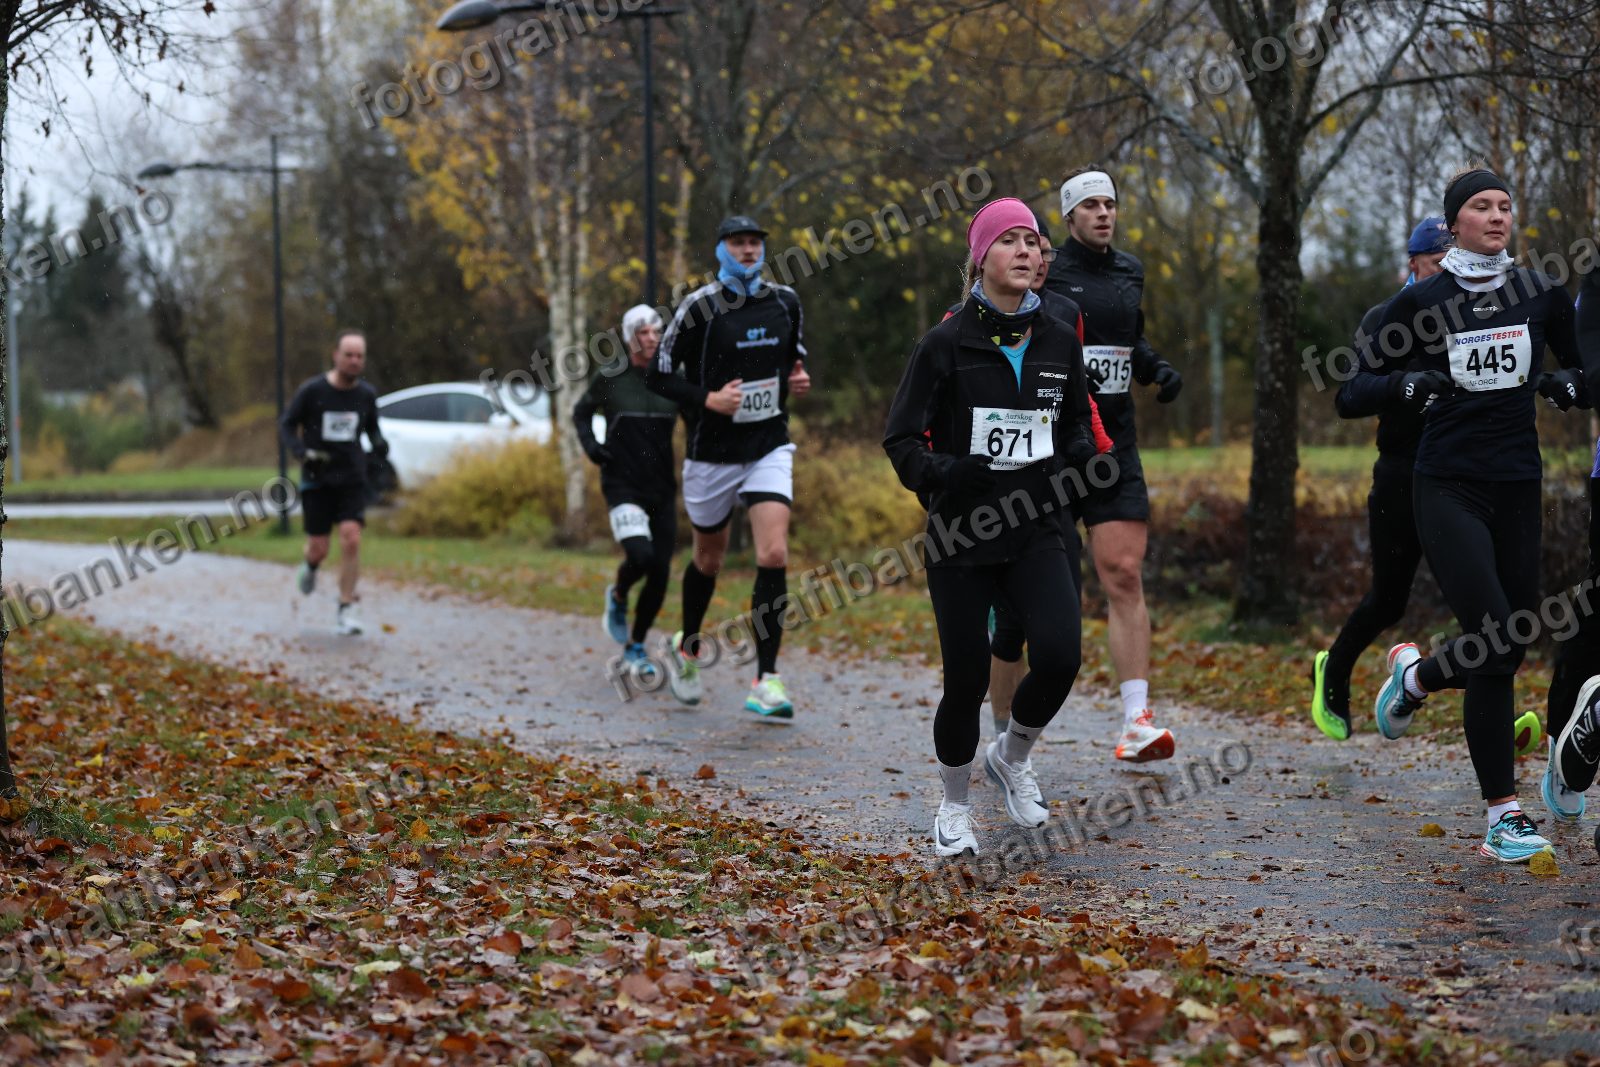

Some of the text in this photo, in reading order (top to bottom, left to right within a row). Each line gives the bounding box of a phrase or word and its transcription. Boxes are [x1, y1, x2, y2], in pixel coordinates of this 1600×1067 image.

[1455, 330, 1523, 345] NORGESTESTEN
[1466, 344, 1517, 376] 445
[743, 390, 771, 412] 402
[987, 428, 1032, 457] 671
